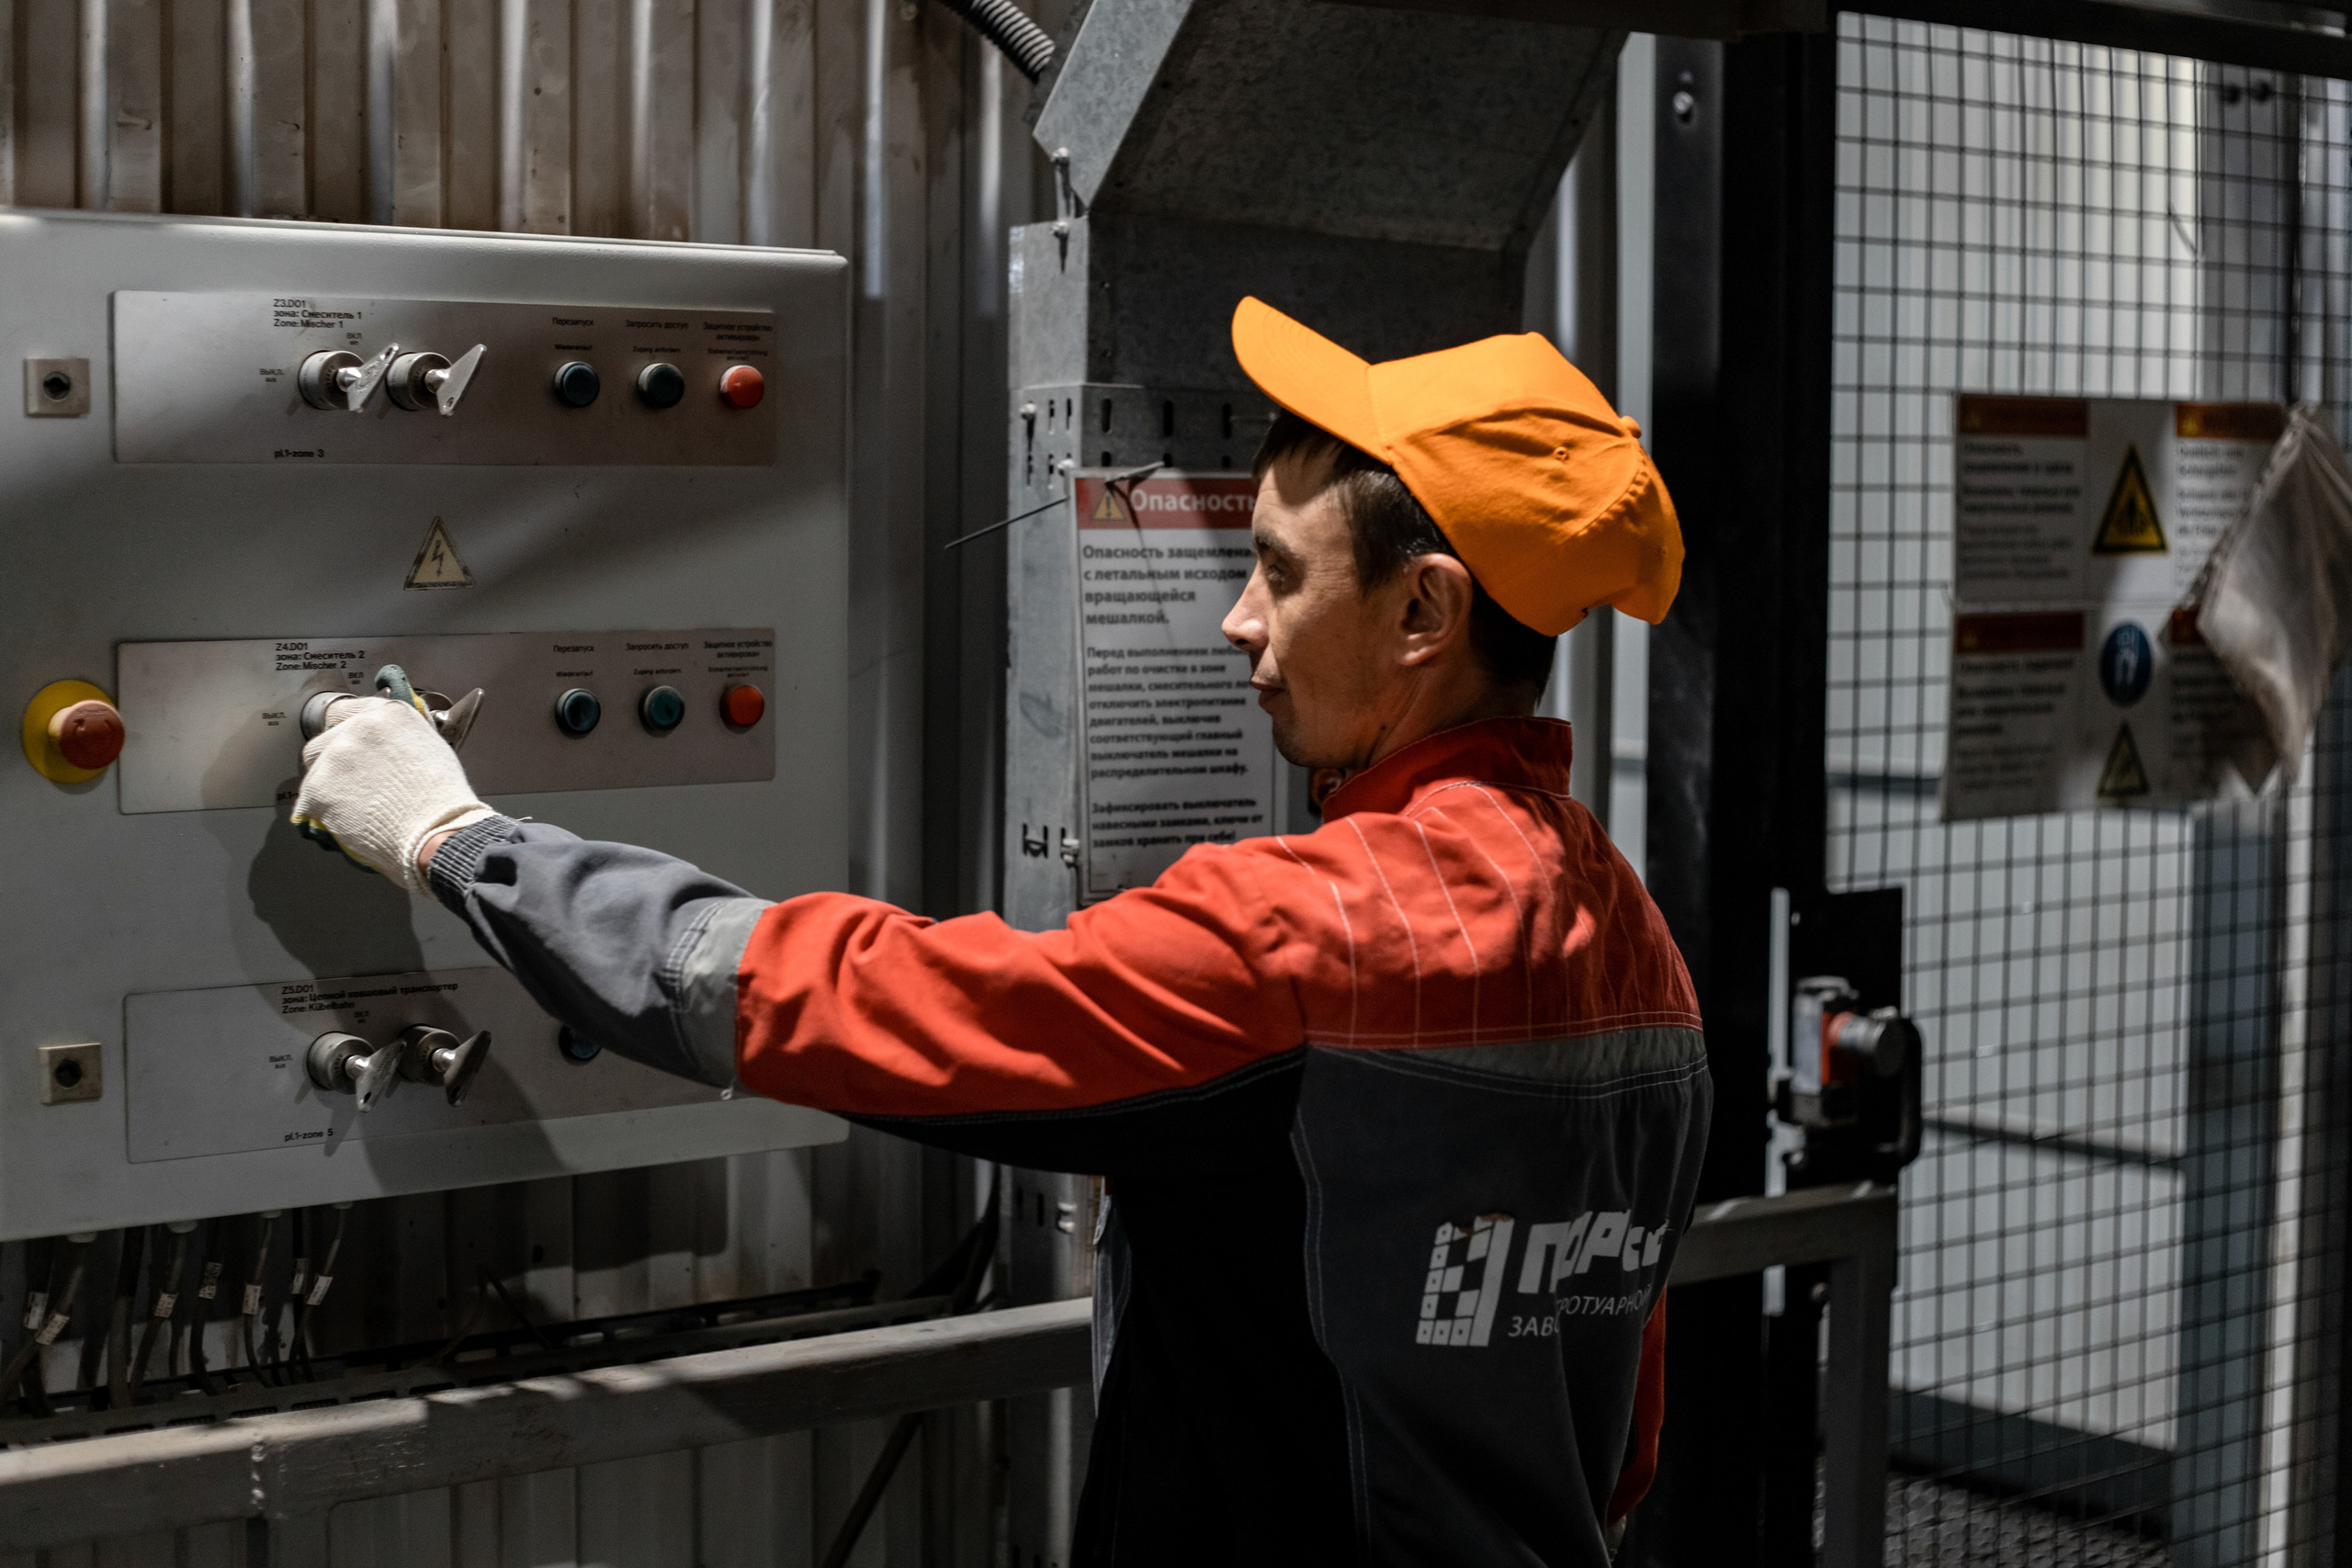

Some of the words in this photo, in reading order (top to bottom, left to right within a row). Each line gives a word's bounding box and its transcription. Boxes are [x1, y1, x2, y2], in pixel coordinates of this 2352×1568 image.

[273, 299, 306, 308] Z3.D01
[274, 310, 300, 318] зона:
[301, 310, 355, 320] Смеситель
[357, 310, 362, 319] 1
[273, 319, 300, 327] Zone:
[300, 319, 337, 328] Mischer
[551, 318, 594, 327] Перезапуск
[318, 449, 324, 457] 3
[1082, 545, 1164, 558] Опасность
[1084, 570, 1091, 581] с
[1094, 570, 1181, 581] летальным
[1184, 569, 1247, 581] исходом
[1085, 589, 1195, 605] вращающейся
[1086, 610, 1170, 625] мешалкой.
[276, 642, 308, 651] Z4.D01
[553, 645, 594, 654] Перезапуск
[276, 652, 302, 661] зона:
[303, 651, 356, 660] Смеситель
[358, 650, 365, 660] 2
[1087, 647, 1125, 660] Перед
[1126, 647, 1208, 658] выполнением
[276, 661, 302, 671] Zone:
[302, 660, 337, 670] Mischer
[340, 660, 346, 669] 2
[1088, 663, 1123, 677] работ
[1125, 665, 1140, 675] по
[1142, 664, 1188, 674] очистке
[1089, 699, 1152, 710] отключить
[1155, 696, 1246, 709] электропитание
[1090, 730, 1193, 745] соответствующий
[1091, 750, 1169, 761] выключатель
[1171, 748, 1223, 759] мешалки
[1226, 748, 1238, 757] на
[1091, 802, 1180, 815] Зафиксировать
[1182, 798, 1257, 810] выключатель
[1251, 814, 1263, 823] от
[281, 985, 314, 995] Z5.D01
[282, 996, 308, 1005] зона:
[400, 983, 458, 996] транспортер
[282, 1005, 308, 1014] Zone:
[327, 1128, 334, 1136] 5
